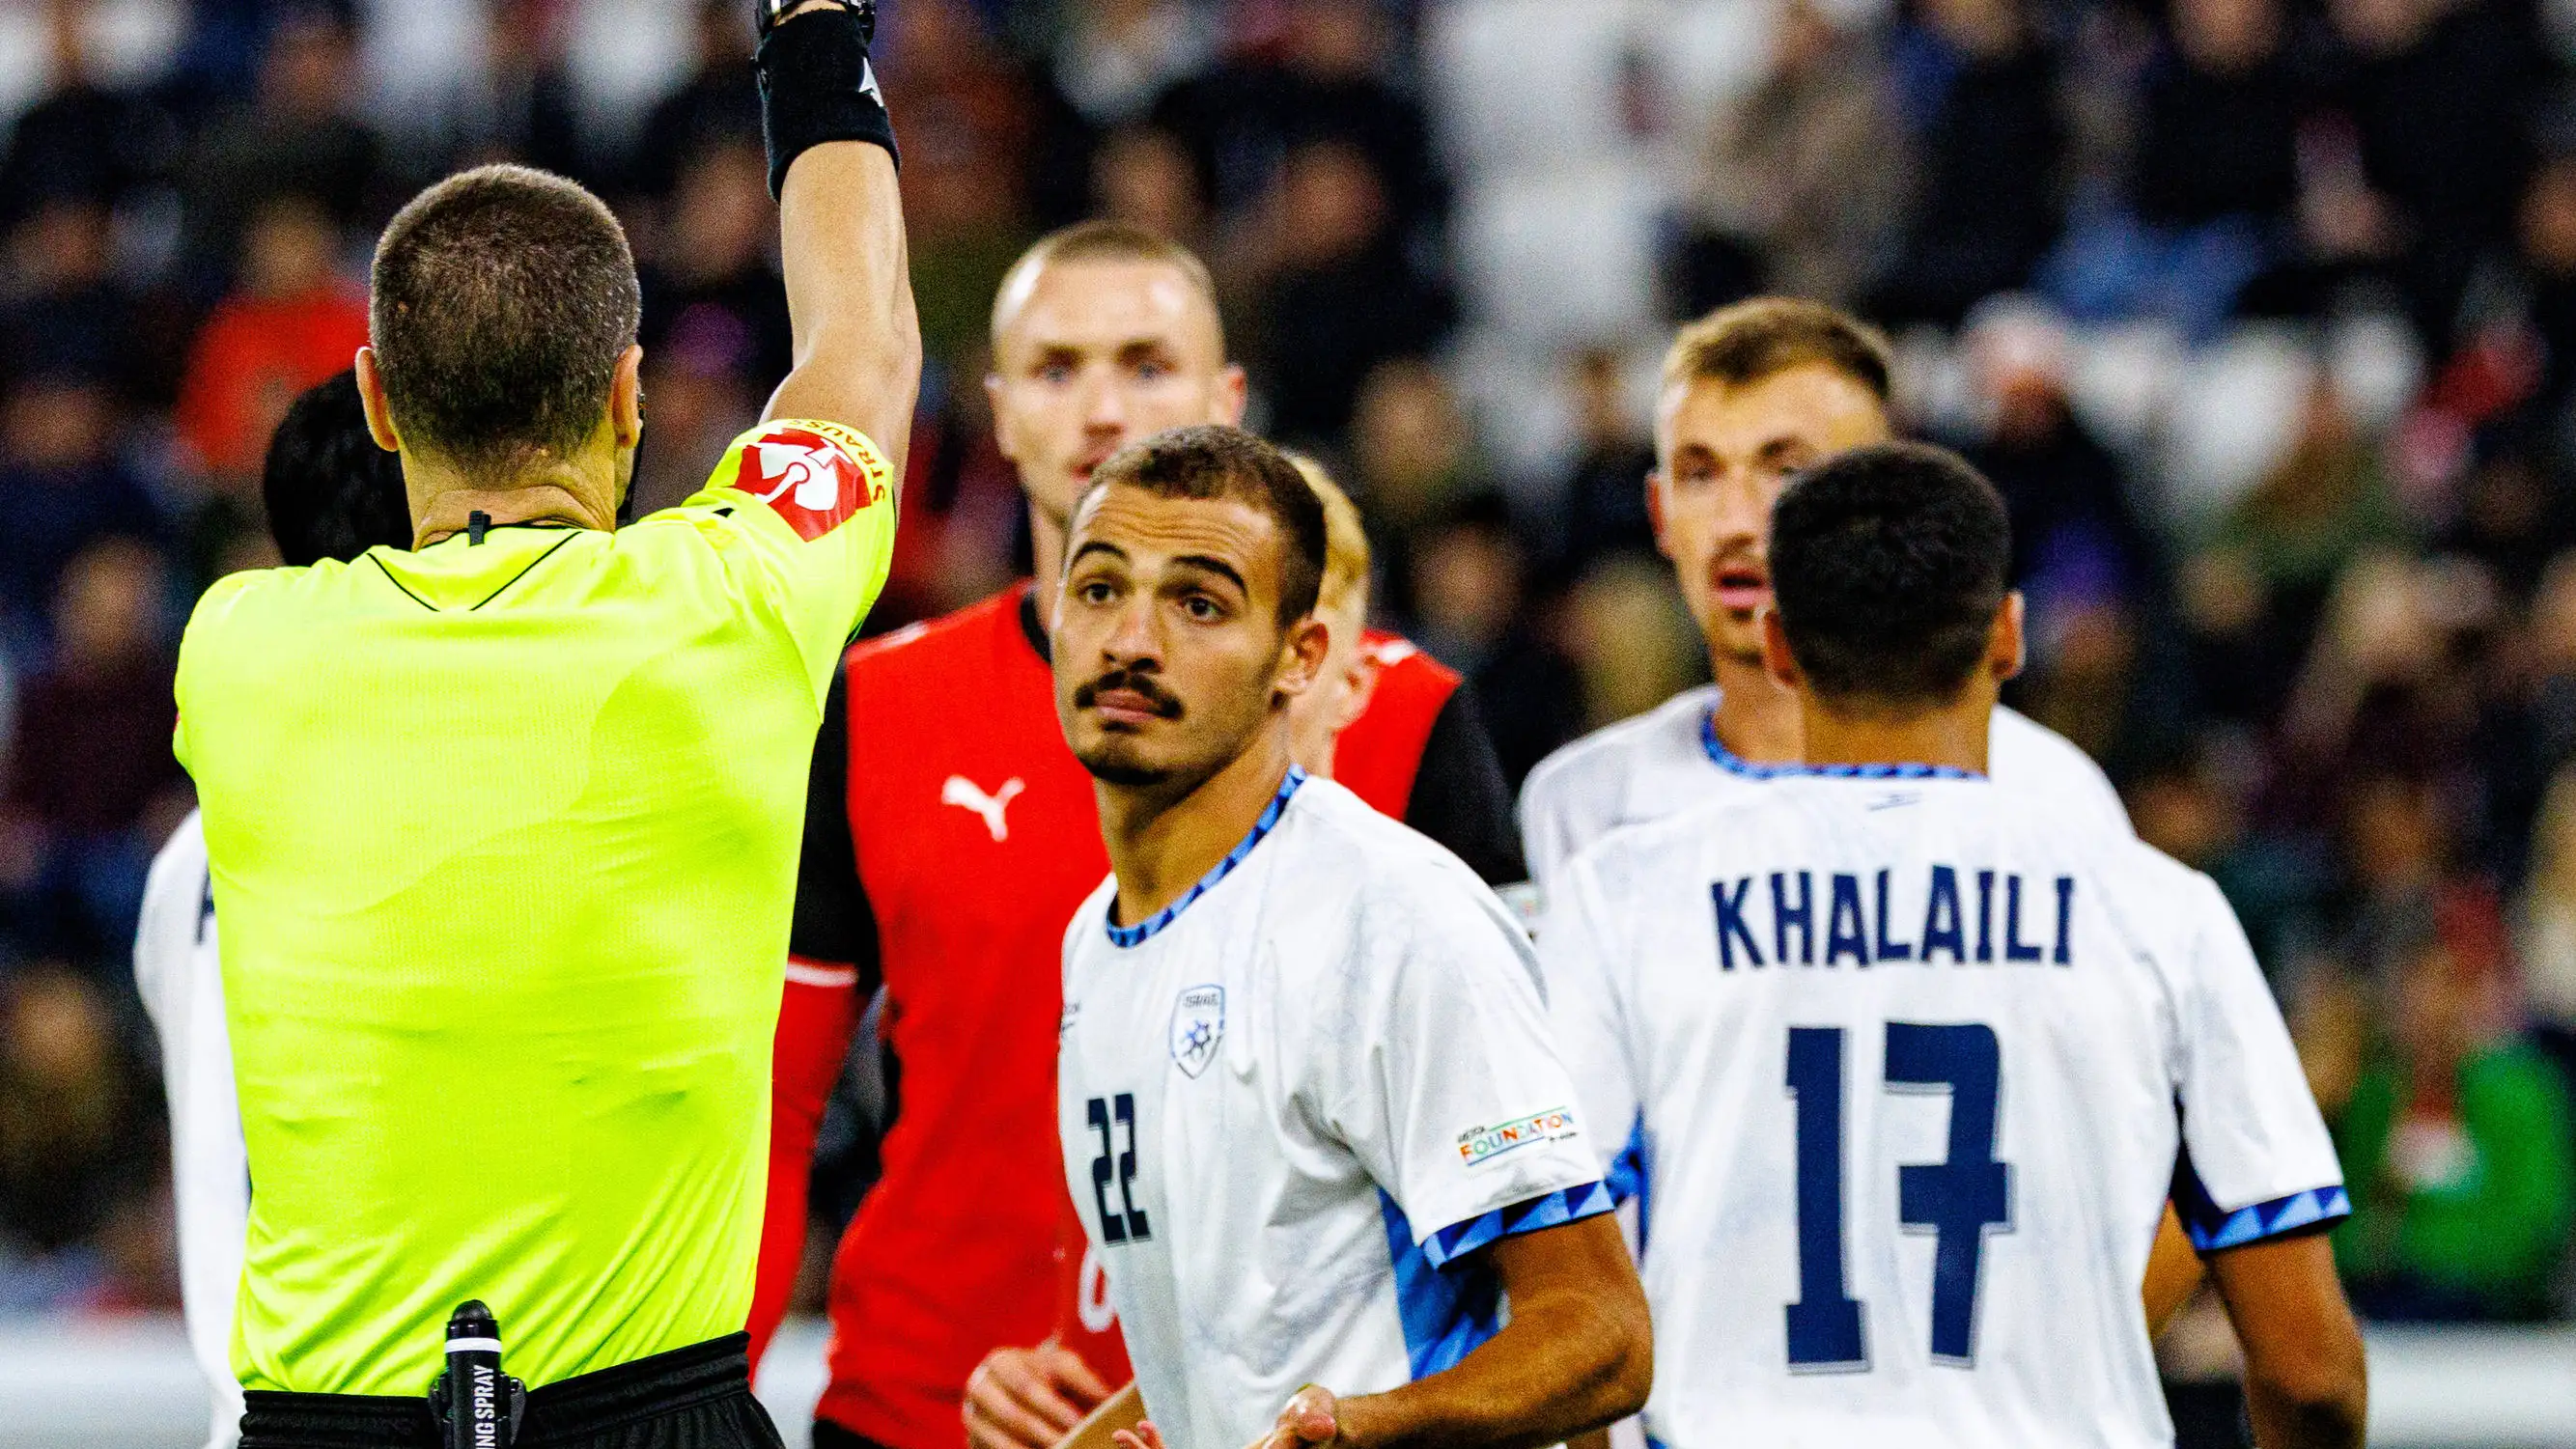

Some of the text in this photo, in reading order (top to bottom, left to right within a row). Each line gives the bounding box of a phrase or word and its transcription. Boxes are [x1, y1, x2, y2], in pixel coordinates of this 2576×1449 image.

[1710, 865, 2074, 970] KHALAILI
[1086, 1093, 1152, 1245] 22
[1784, 1020, 2017, 1375] 17
[472, 1364, 495, 1419] SPRAY
